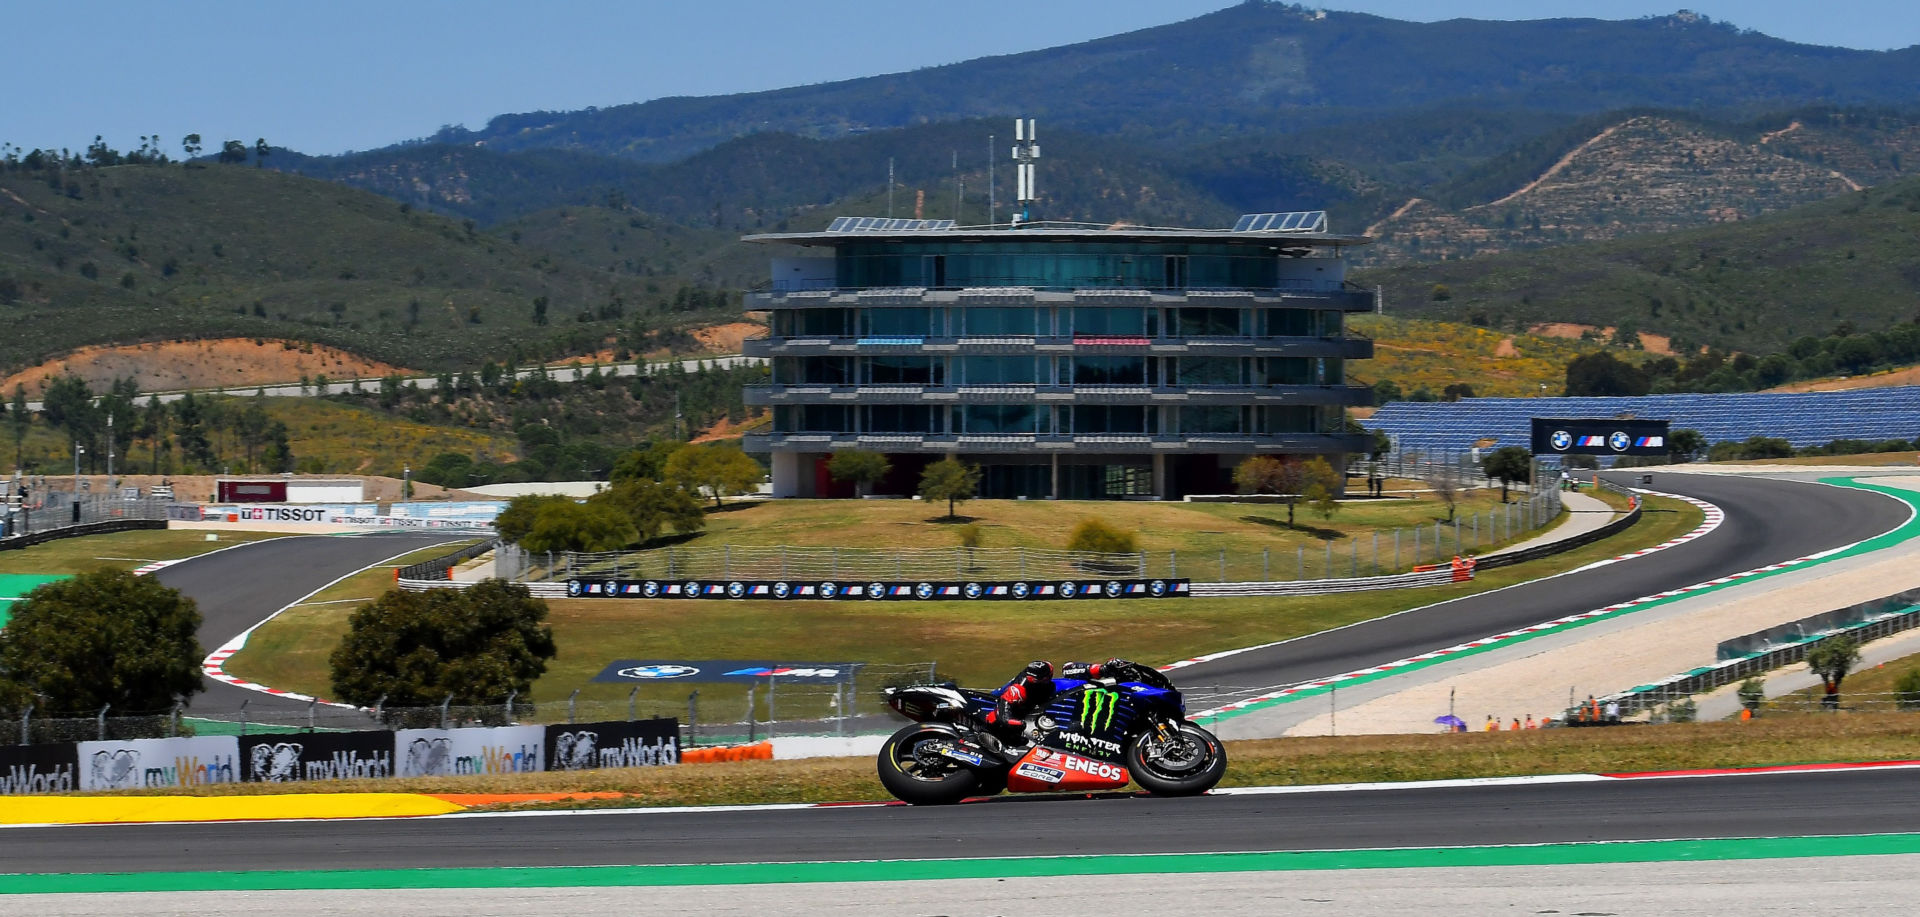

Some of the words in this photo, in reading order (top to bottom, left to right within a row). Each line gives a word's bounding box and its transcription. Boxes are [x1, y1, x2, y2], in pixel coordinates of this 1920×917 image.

[264, 508, 326, 521] TISSOT
[305, 750, 389, 781] myWorld
[455, 743, 537, 774] myWorld
[600, 736, 676, 768] myWorld
[0, 763, 72, 795] yWorld
[145, 754, 233, 787] myWorld
[1023, 771, 1054, 781] CORE
[1064, 756, 1121, 780] ENEOS
